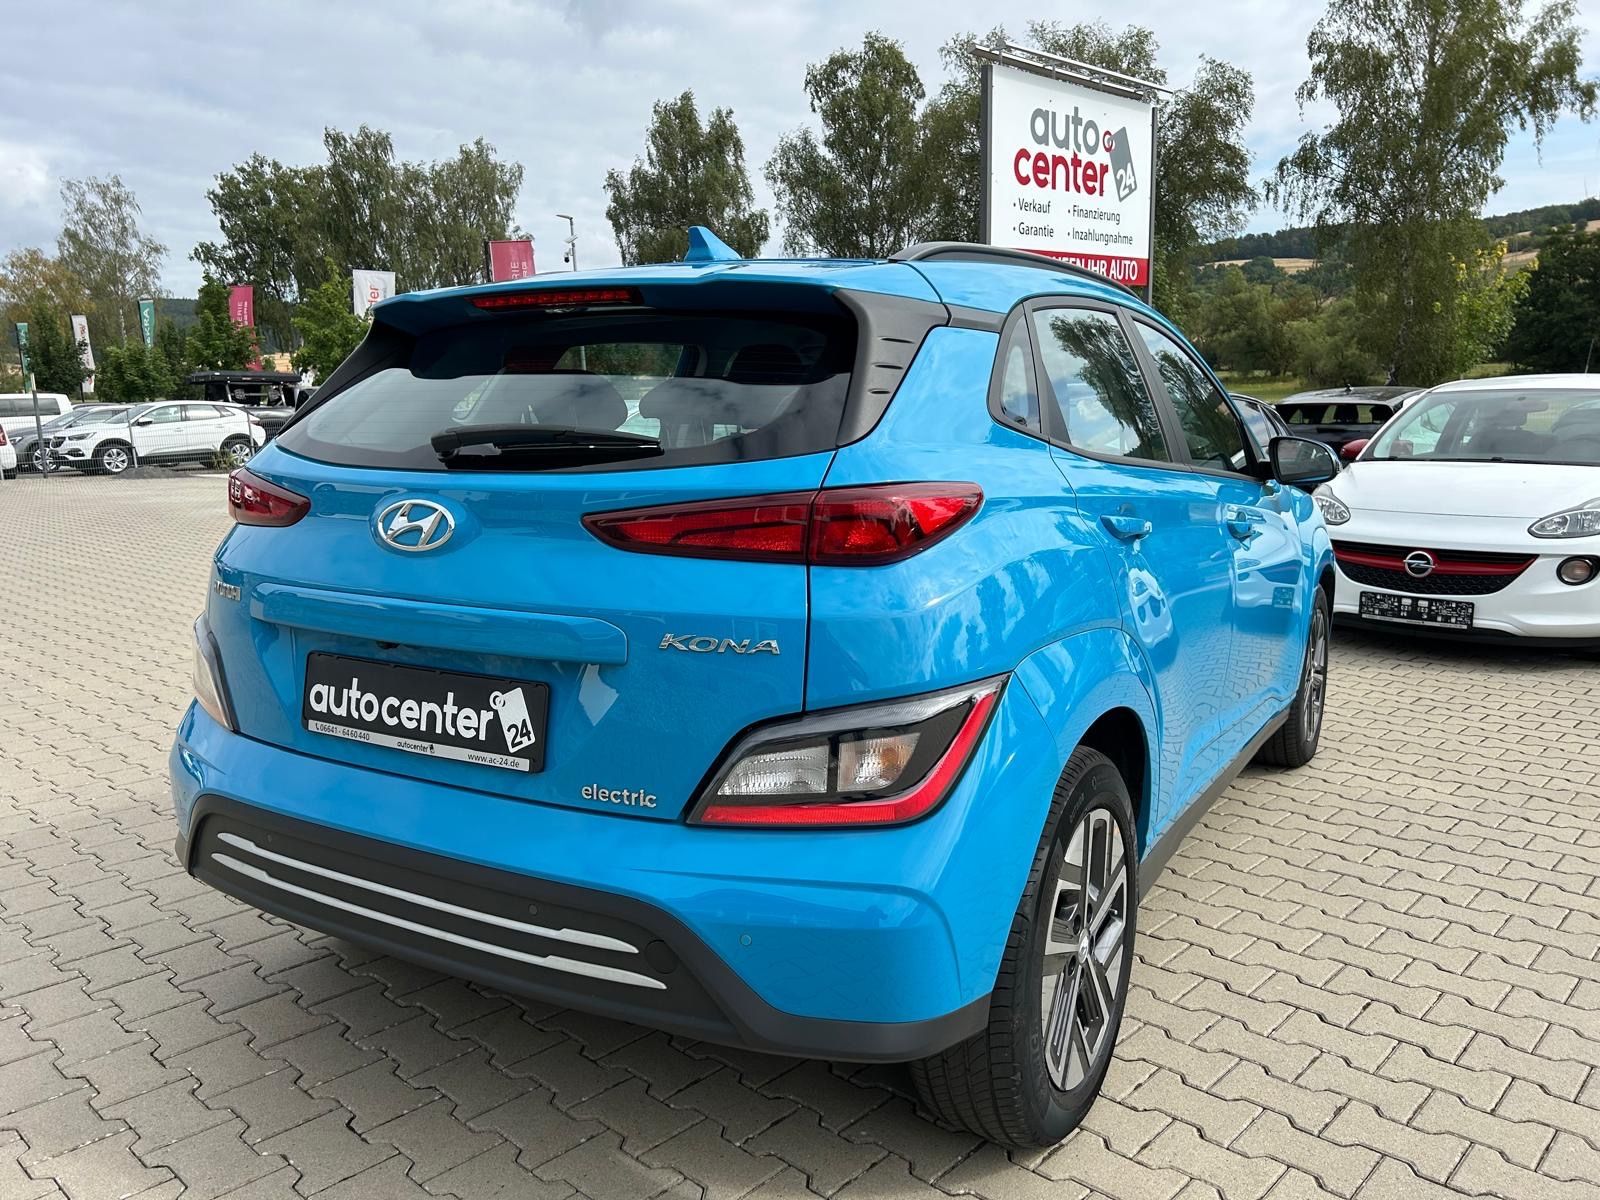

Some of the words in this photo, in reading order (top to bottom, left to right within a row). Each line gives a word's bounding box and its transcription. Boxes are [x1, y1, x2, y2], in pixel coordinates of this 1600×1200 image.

[1030, 106, 1100, 156] auto
[1013, 147, 1109, 197] center
[1116, 162, 1136, 198] 24
[1018, 197, 1051, 214] Verkauf
[1072, 204, 1121, 226] Finanzierung
[1018, 222, 1054, 238] Garantie
[1072, 227, 1134, 246] Inzahlungnahme
[510, 261, 520, 280] RIE
[1109, 259, 1138, 281] AUTO
[659, 633, 780, 655] KONA
[309, 677, 494, 741] autocenter
[320, 723, 338, 734] 06641
[507, 718, 532, 749] 24
[397, 740, 429, 753] autocenter
[467, 753, 520, 768] www.ac-24.de
[581, 783, 657, 808] electric
